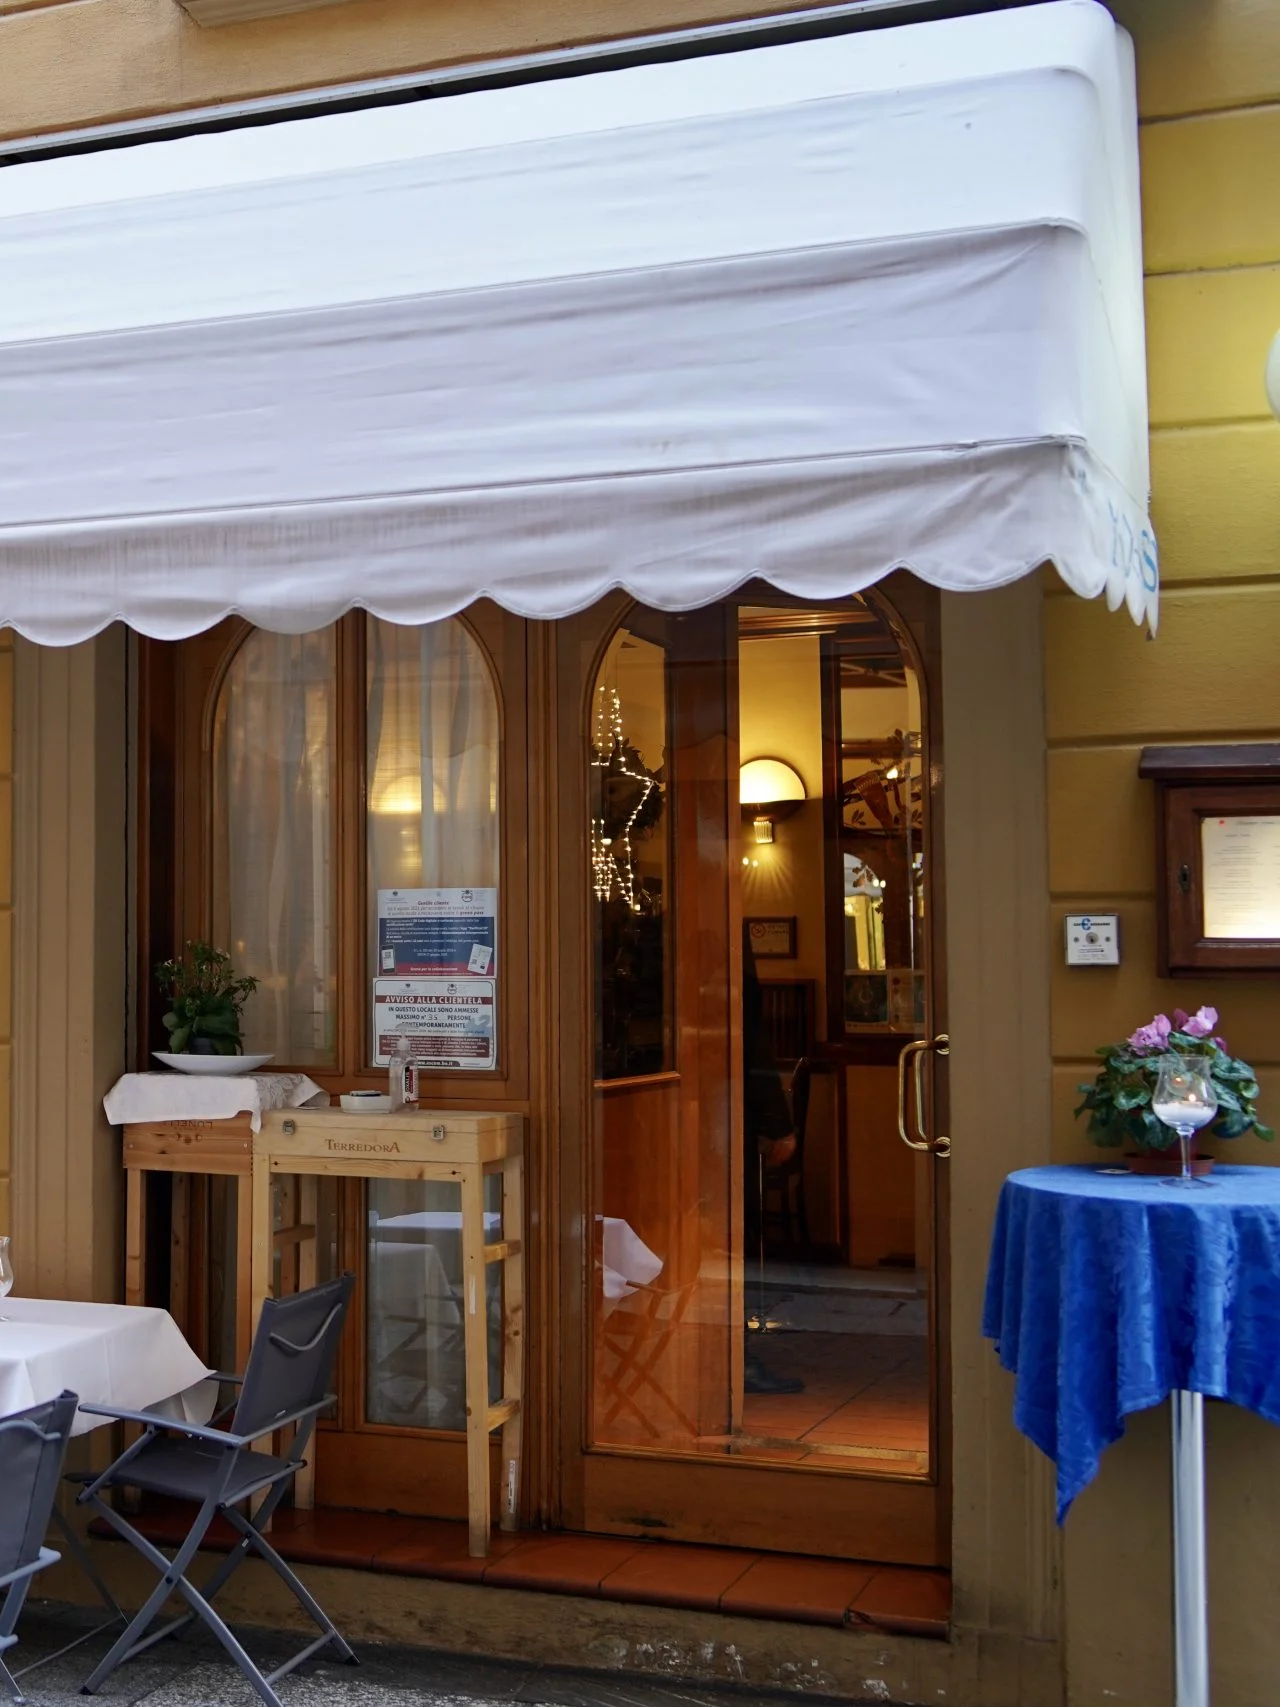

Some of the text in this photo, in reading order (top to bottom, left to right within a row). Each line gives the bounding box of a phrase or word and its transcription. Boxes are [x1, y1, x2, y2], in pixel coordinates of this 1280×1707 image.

[385, 995, 483, 1005] AVVISO ALLA CLIENTELA
[324, 1138, 401, 1153] TERREDORA
